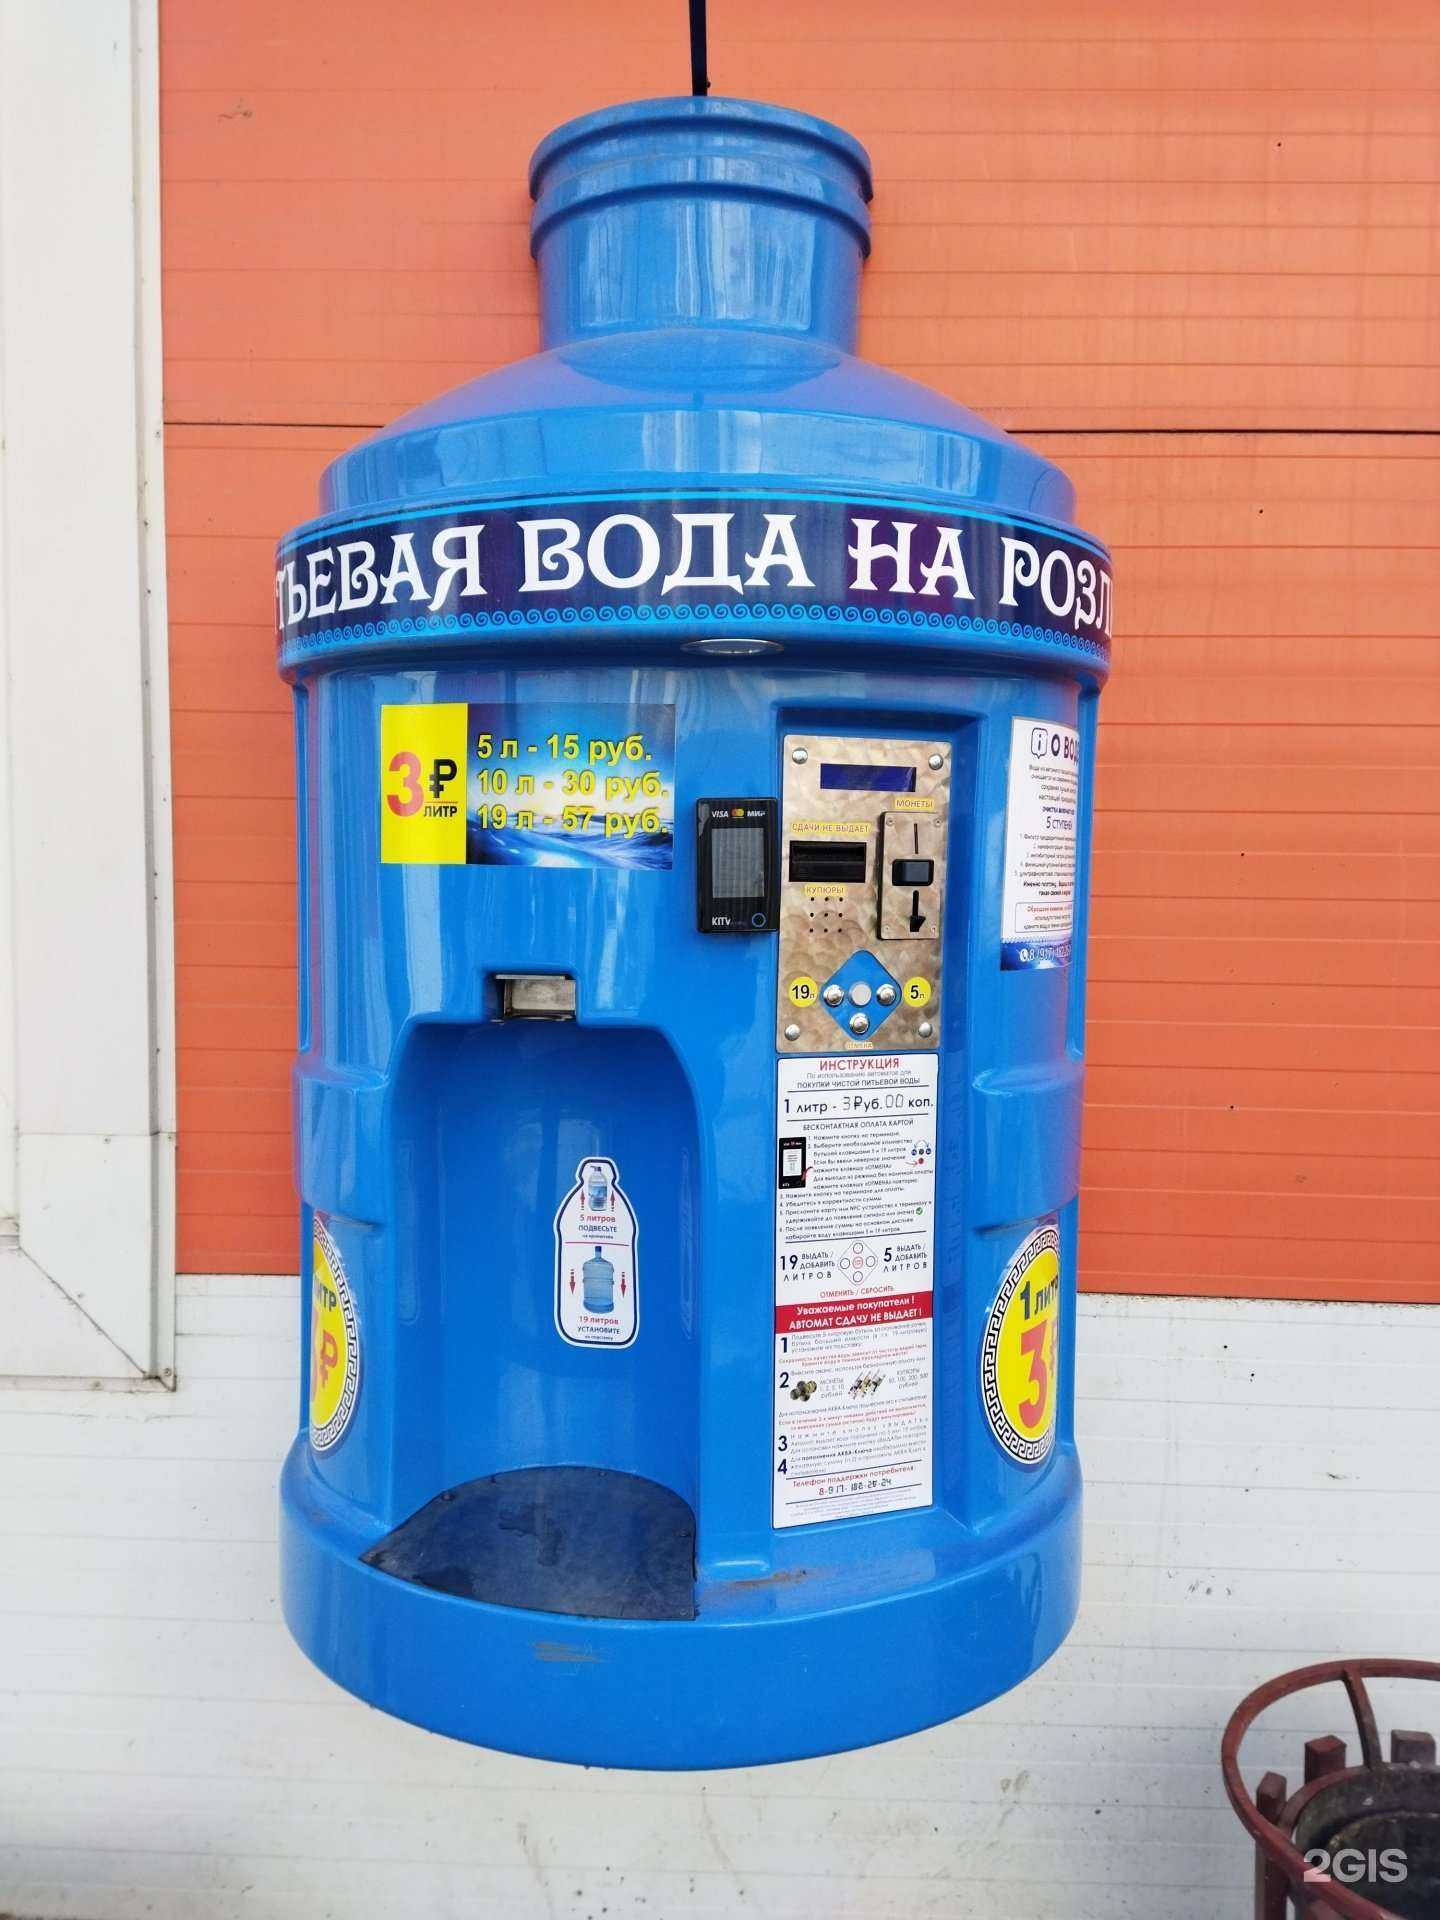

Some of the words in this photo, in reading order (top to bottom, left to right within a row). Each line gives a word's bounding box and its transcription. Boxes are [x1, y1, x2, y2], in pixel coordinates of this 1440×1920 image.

[517, 513, 816, 596] ВОДА
[848, 518, 975, 600] НА
[477, 733, 493, 759] 5
[500, 739, 519, 759] л
[527, 745, 538, 753] -
[546, 733, 580, 760] 15
[588, 733, 652, 766] руб.
[1051, 734, 1060, 756] О
[478, 768, 508, 795] 10
[515, 774, 534, 796] л
[543, 781, 554, 789] -
[562, 769, 596, 796] 30
[605, 771, 669, 803] руб.
[423, 805, 458, 818] ЛИТР
[896, 800, 933, 808] МОНЕТЫ
[478, 804, 508, 830] 19
[515, 811, 533, 830] л
[562, 805, 596, 832] 57
[605, 807, 669, 838] руб.
[711, 810, 729, 818] VISA
[806, 886, 844, 894] КУПЮРЫ
[820, 1058, 900, 1071] ИНСТРУКЦИЯ
[797, 1081, 830, 1089] ПОКУПКИ
[832, 1079, 860, 1087] ЧИСТОЙ
[862, 1078, 898, 1086] ПИТЬЕВОЙ
[900, 1077, 920, 1085] ВОДЫ
[784, 1099, 789, 1113] 1
[797, 1102, 828, 1115] литр
[908, 1098, 934, 1108] коп.
[803, 1121, 858, 1131] БЕСКОНТАКТНАЯ
[860, 1120, 887, 1128] ОПЛАТА
[889, 1118, 914, 1127] КАРТОЙ
[587, 1215, 616, 1223] литров
[578, 1225, 617, 1233] ПОДВЕСЬТЕ
[884, 1247, 892, 1262] 5
[895, 1252, 928, 1262] ДОБАВИТЬ
[780, 1255, 798, 1271] 19
[800, 1261, 836, 1270] ДОБАВИТЬ
[820, 1290, 854, 1299] ОТМЕНИТЬ
[860, 1286, 894, 1296] СБРОСИТЬ
[1020, 1280, 1030, 1320] 1
[797, 1305, 855, 1316] Уважаемые
[857, 1298, 910, 1310] покупатели
[579, 1315, 589, 1323] 19
[590, 1317, 619, 1325] литров
[789, 1318, 833, 1330] АВТОМАТ
[835, 1315, 868, 1327] СДАЧУ
[871, 1312, 881, 1321] НЕ
[884, 1309, 917, 1321] ВЫДАЕТ
[578, 1326, 621, 1335] УСТАНОВИТЕ
[780, 1337, 788, 1353] 1
[780, 1372, 789, 1388] 2
[1019, 1320, 1047, 1428] 3
[778, 1435, 787, 1451] 3
[777, 1458, 787, 1475] 4
[793, 1478, 826, 1488] Телефон
[828, 1472, 868, 1485] поддержки
[870, 1466, 914, 1478] потребителя
